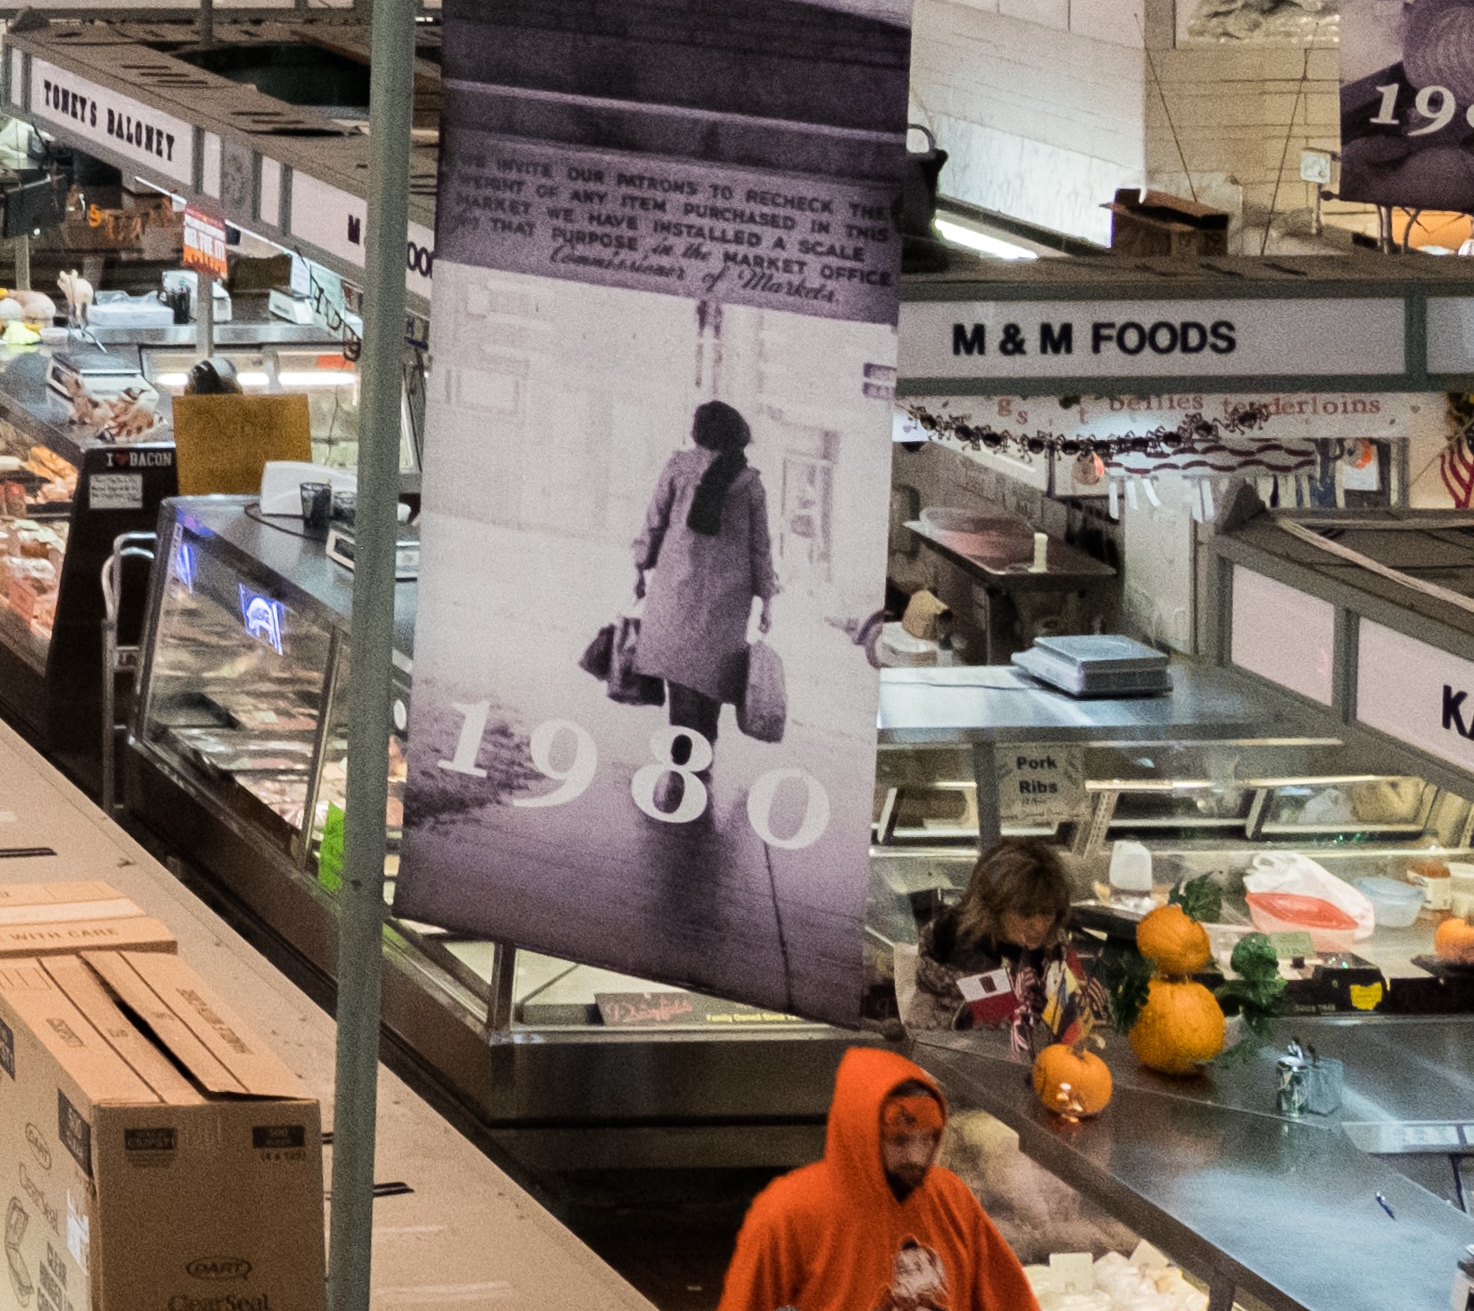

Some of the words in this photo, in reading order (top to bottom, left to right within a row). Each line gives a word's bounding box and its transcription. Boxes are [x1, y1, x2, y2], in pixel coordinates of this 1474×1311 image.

[43, 83, 98, 128] TONEY'S
[107, 109, 175, 161] BALONEY
[1369, 81, 1474, 136] 19
[567, 166, 605, 185] OUR
[617, 172, 699, 196] PATRONS
[708, 184, 734, 201] TO
[745, 188, 834, 215] RECHECK
[570, 189, 608, 207] ANY
[621, 195, 667, 213] ITEM
[683, 202, 797, 231] PURCHASED
[810, 219, 831, 234] IN
[490, 216, 535, 238] THAT
[551, 227, 638, 252] PURPOSE
[723, 250, 808, 275] MARKET
[820, 265, 893, 288] OFFICE
[547, 206, 574, 224] WE
[588, 211, 638, 231] HAVE
[653, 218, 762, 248] INSTALLED
[772, 235, 786, 252] A
[798, 239, 865, 263] SCALE
[952, 322, 986, 356] M
[998, 321, 1027, 356] &
[1039, 322, 1073, 355] M
[1091, 320, 1237, 355] FOODS
[106, 452, 114, 467] I
[129, 452, 173, 467] BACON
[1442, 684, 1474, 741] K
[436, 698, 832, 852] 1980
[1016, 755, 1058, 771] Pork
[1018, 779, 1059, 794] Ribs
[10, 928, 61, 942] WITH
[68, 926, 120, 939] CARE
[194, 1261, 245, 1275] DART
